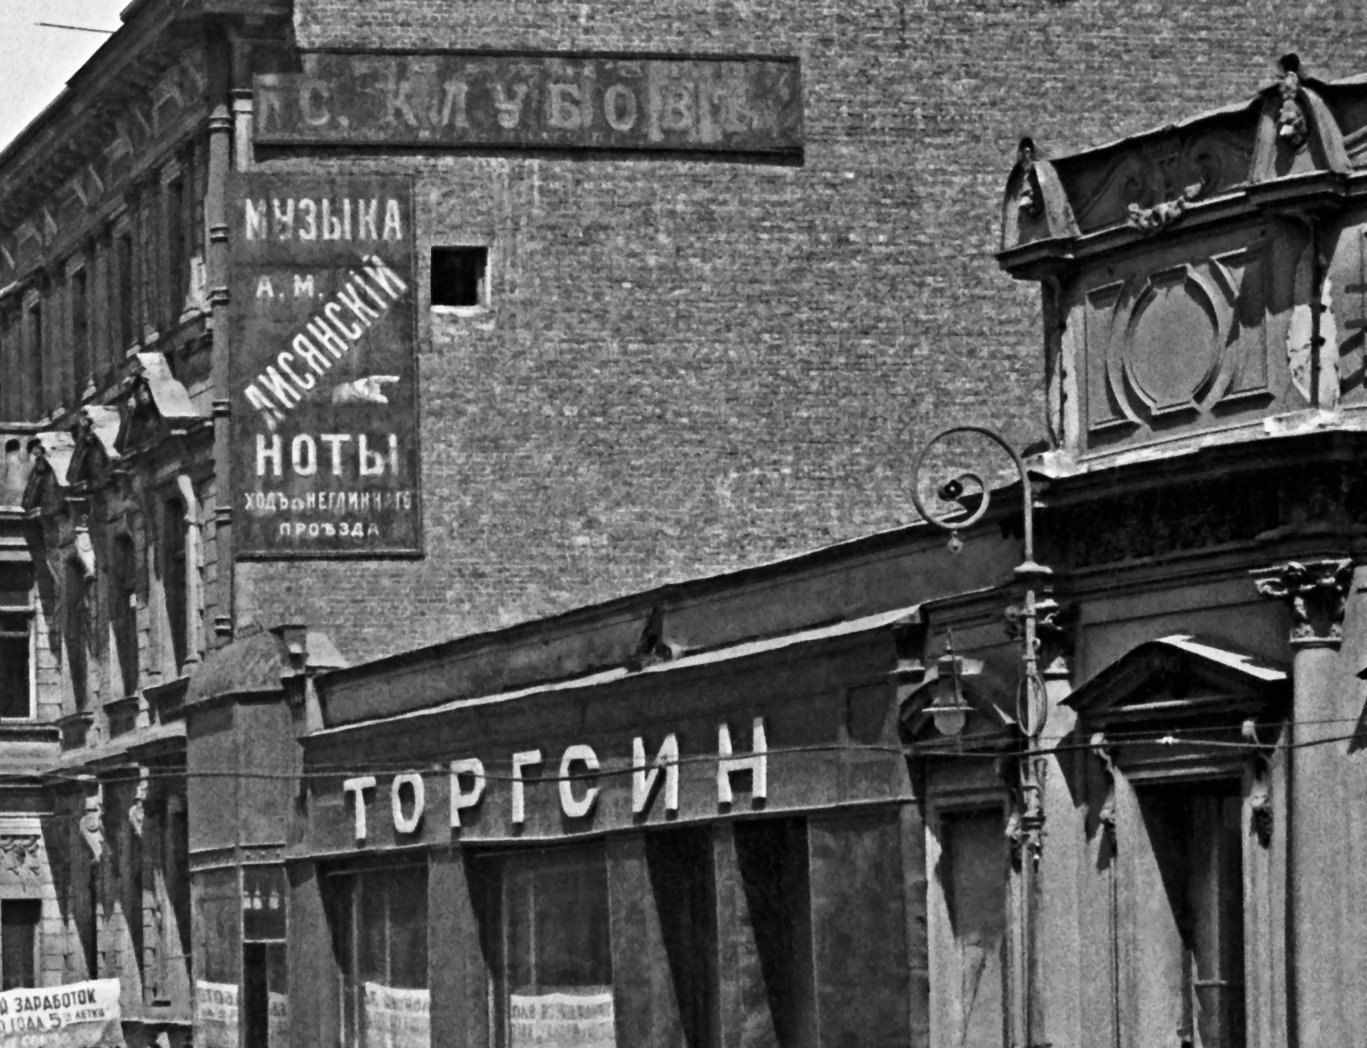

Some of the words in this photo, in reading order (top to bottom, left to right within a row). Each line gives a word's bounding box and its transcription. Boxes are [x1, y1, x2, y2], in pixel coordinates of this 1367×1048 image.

[244, 197, 403, 241] МУЗЫКА
[255, 433, 399, 478] НОТЫ
[343, 716, 768, 841] ТОРГСИН
[14, 988, 97, 1013] ЗАРАБОТОК
